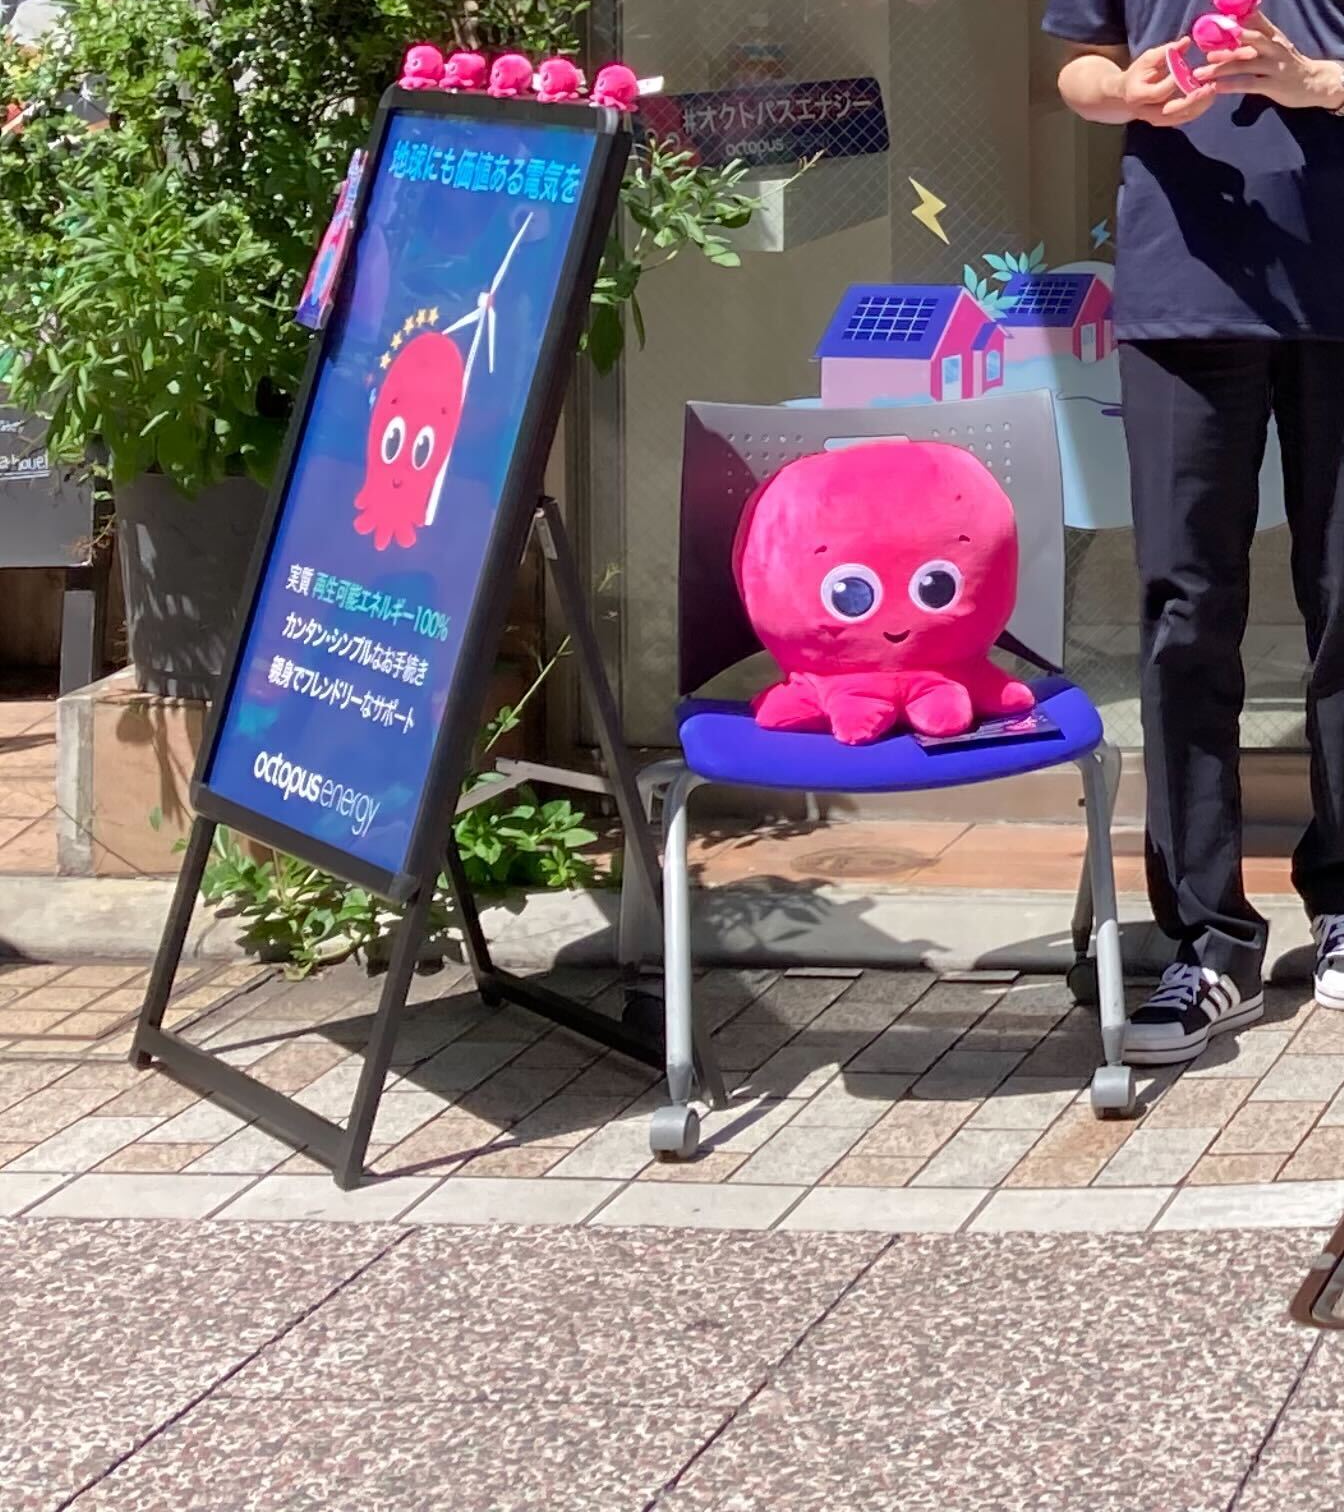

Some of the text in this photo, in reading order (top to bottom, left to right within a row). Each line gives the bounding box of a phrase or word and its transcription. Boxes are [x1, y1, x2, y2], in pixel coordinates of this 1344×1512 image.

[682, 92, 872, 134] #オクトパスエナジー
[389, 140, 581, 204] 地球にも価値ある電気を
[725, 137, 785, 161] octopus
[281, 611, 429, 687] カンタン・シンプルなお手続き
[267, 655, 416, 734] 親身でフレンドリーなサポート
[253, 749, 380, 837] octopus energy
